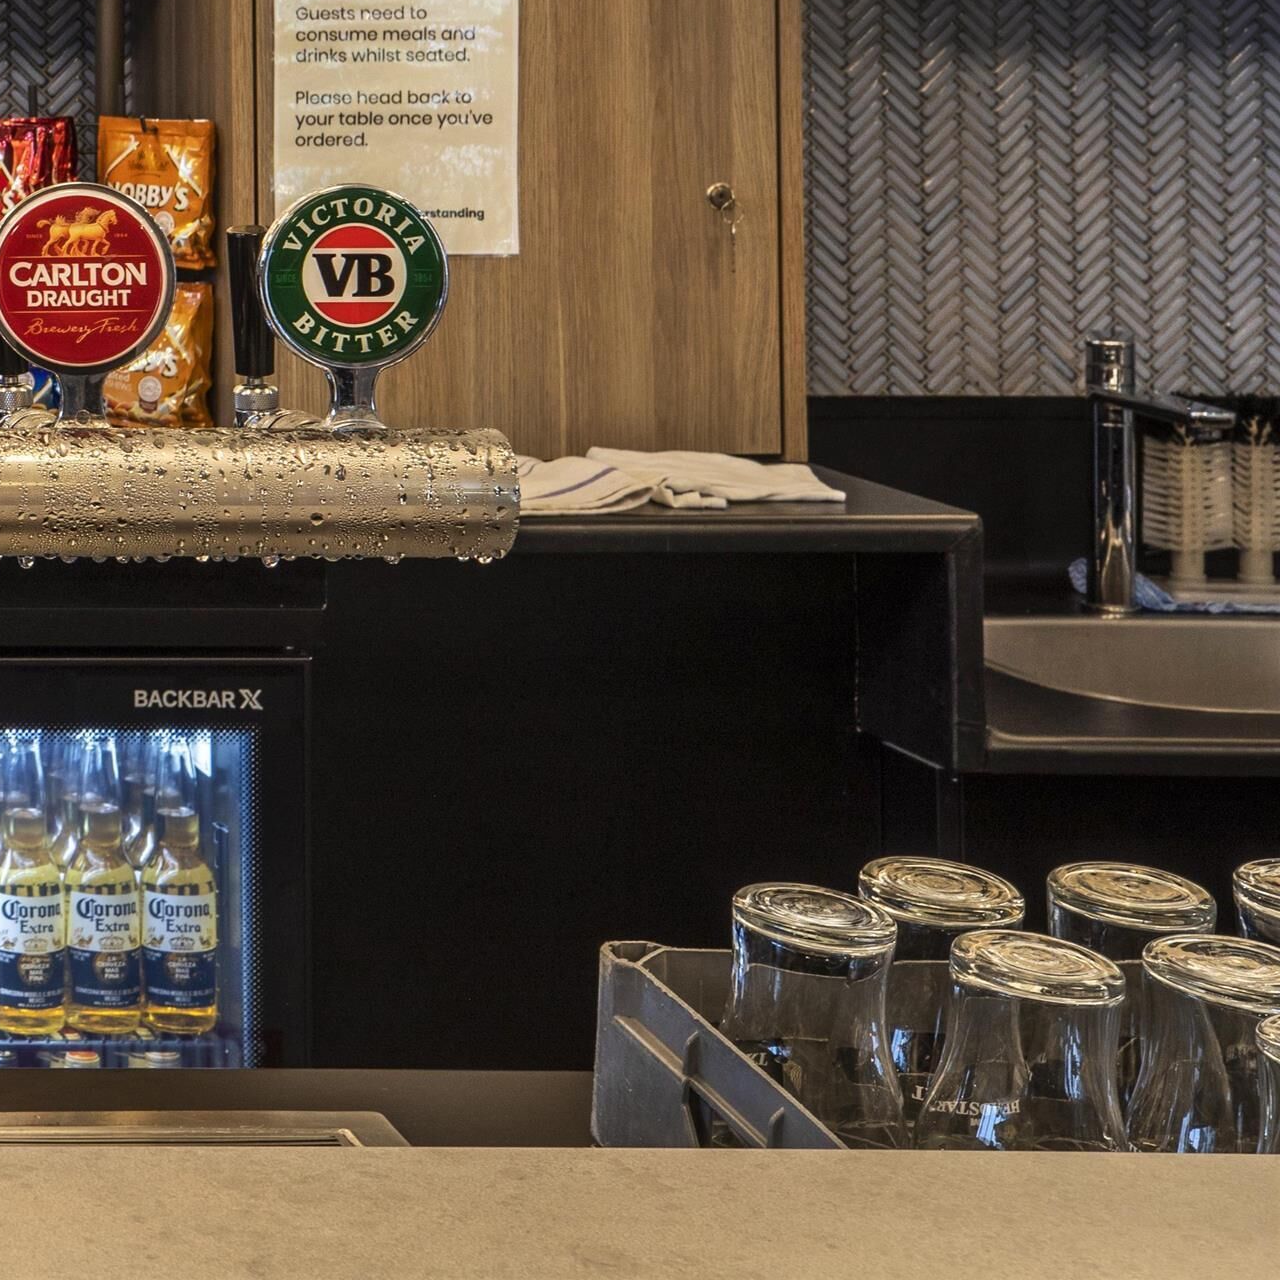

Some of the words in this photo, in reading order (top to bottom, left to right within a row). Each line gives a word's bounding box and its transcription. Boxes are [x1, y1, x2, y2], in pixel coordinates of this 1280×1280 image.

[295, 6, 356, 21] Guests
[360, 6, 405, 21] need
[410, 7, 427, 20] to
[295, 29, 378, 42] consume
[382, 26, 436, 41] meals
[441, 26, 476, 41] and
[295, 48, 347, 63] drinks
[351, 48, 401, 63] whilst
[406, 48, 471, 63] seated.
[295, 90, 352, 105] Please
[357, 90, 402, 105] head
[407, 90, 450, 105] back
[455, 91, 472, 104] to
[295, 114, 334, 130] your
[339, 112, 384, 126] table
[388, 113, 433, 126] once
[437, 111, 493, 130] you've
[295, 133, 369, 147] ordered.
[282, 197, 426, 255] VICTORIA
[9, 262, 147, 287] CARLTON
[312, 253, 396, 298] VB
[27, 289, 131, 307] DRAUGHT
[24, 318, 93, 343] Brewery
[92, 317, 138, 335] Fresh
[292, 310, 420, 354] BITTER
[134, 690, 236, 709] BACKBAR
[1, 899, 61, 922] Corona
[76, 897, 137, 921] Corona
[148, 897, 210, 921] Corona
[19, 921, 54, 934] Extra
[94, 919, 130, 933] Extra
[165, 920, 201, 933] Extra
